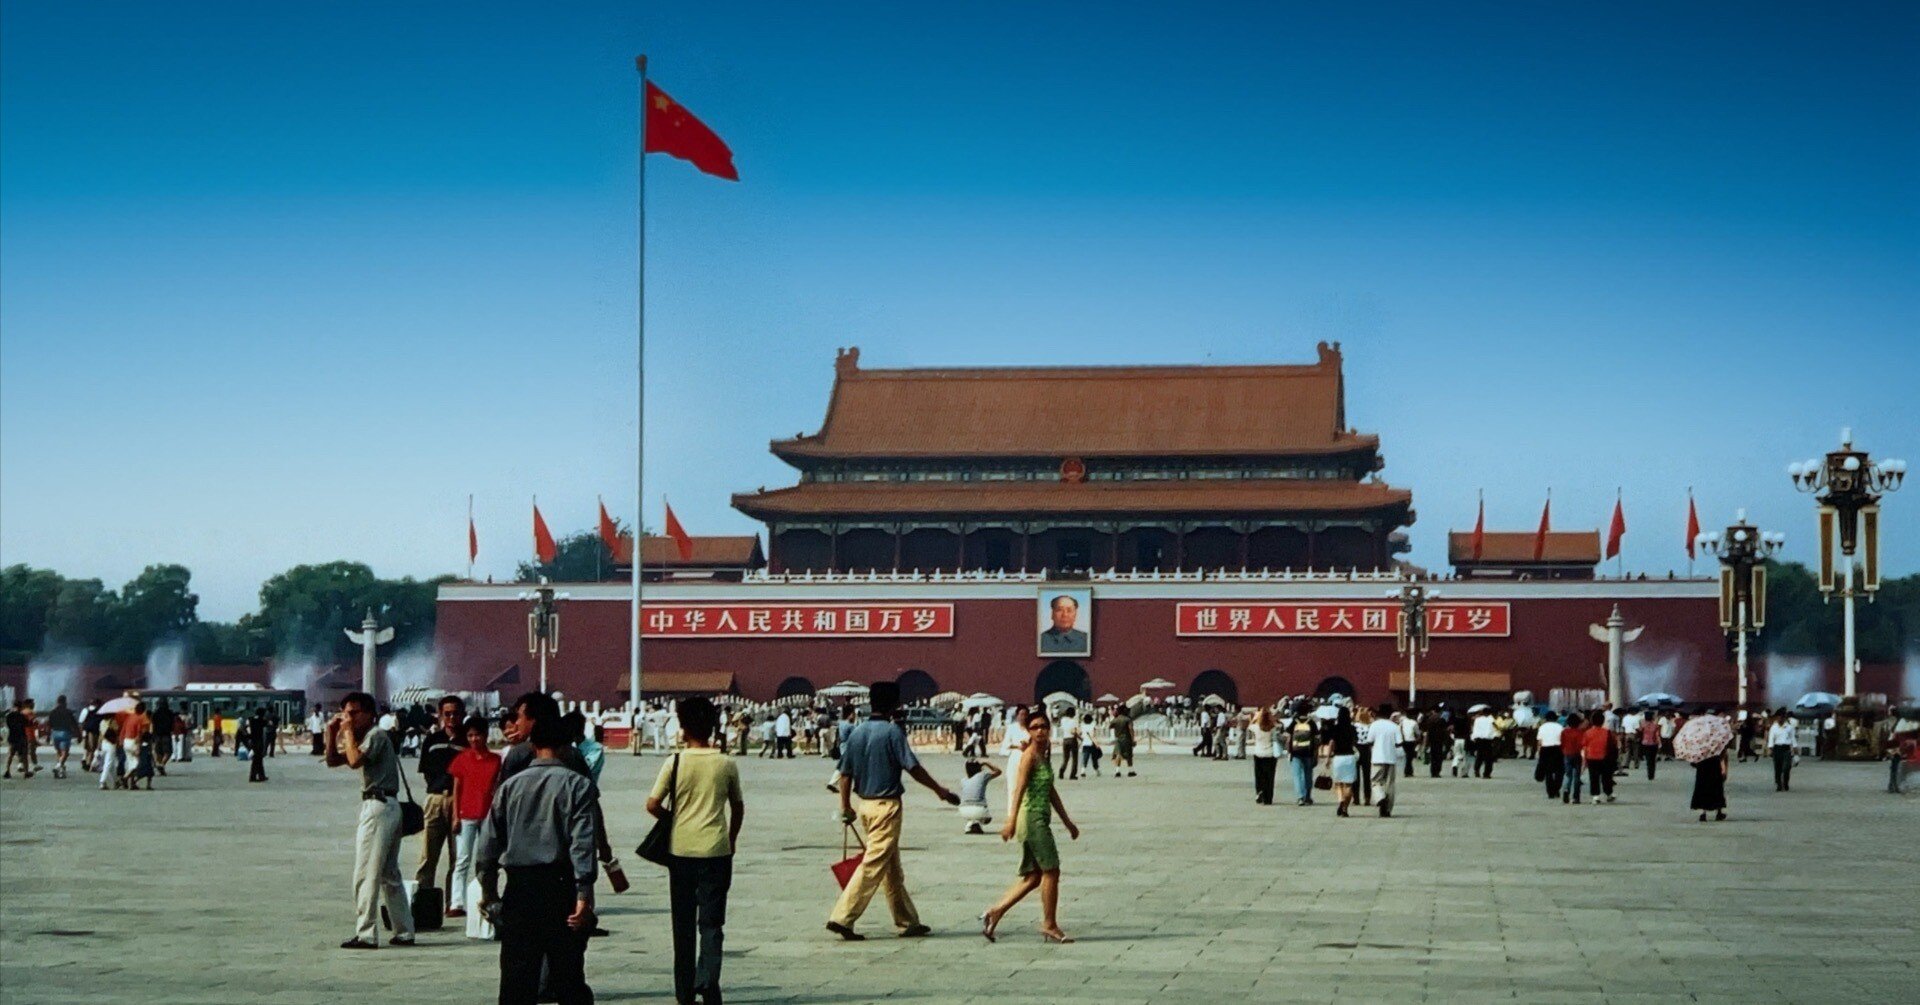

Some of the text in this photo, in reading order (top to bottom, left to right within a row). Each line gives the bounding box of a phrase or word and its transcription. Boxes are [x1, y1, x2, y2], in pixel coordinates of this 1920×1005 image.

[649, 610, 936, 632] 中华人民共和国万岁
[1195, 608, 1492, 631] 世界人民大团万岁
